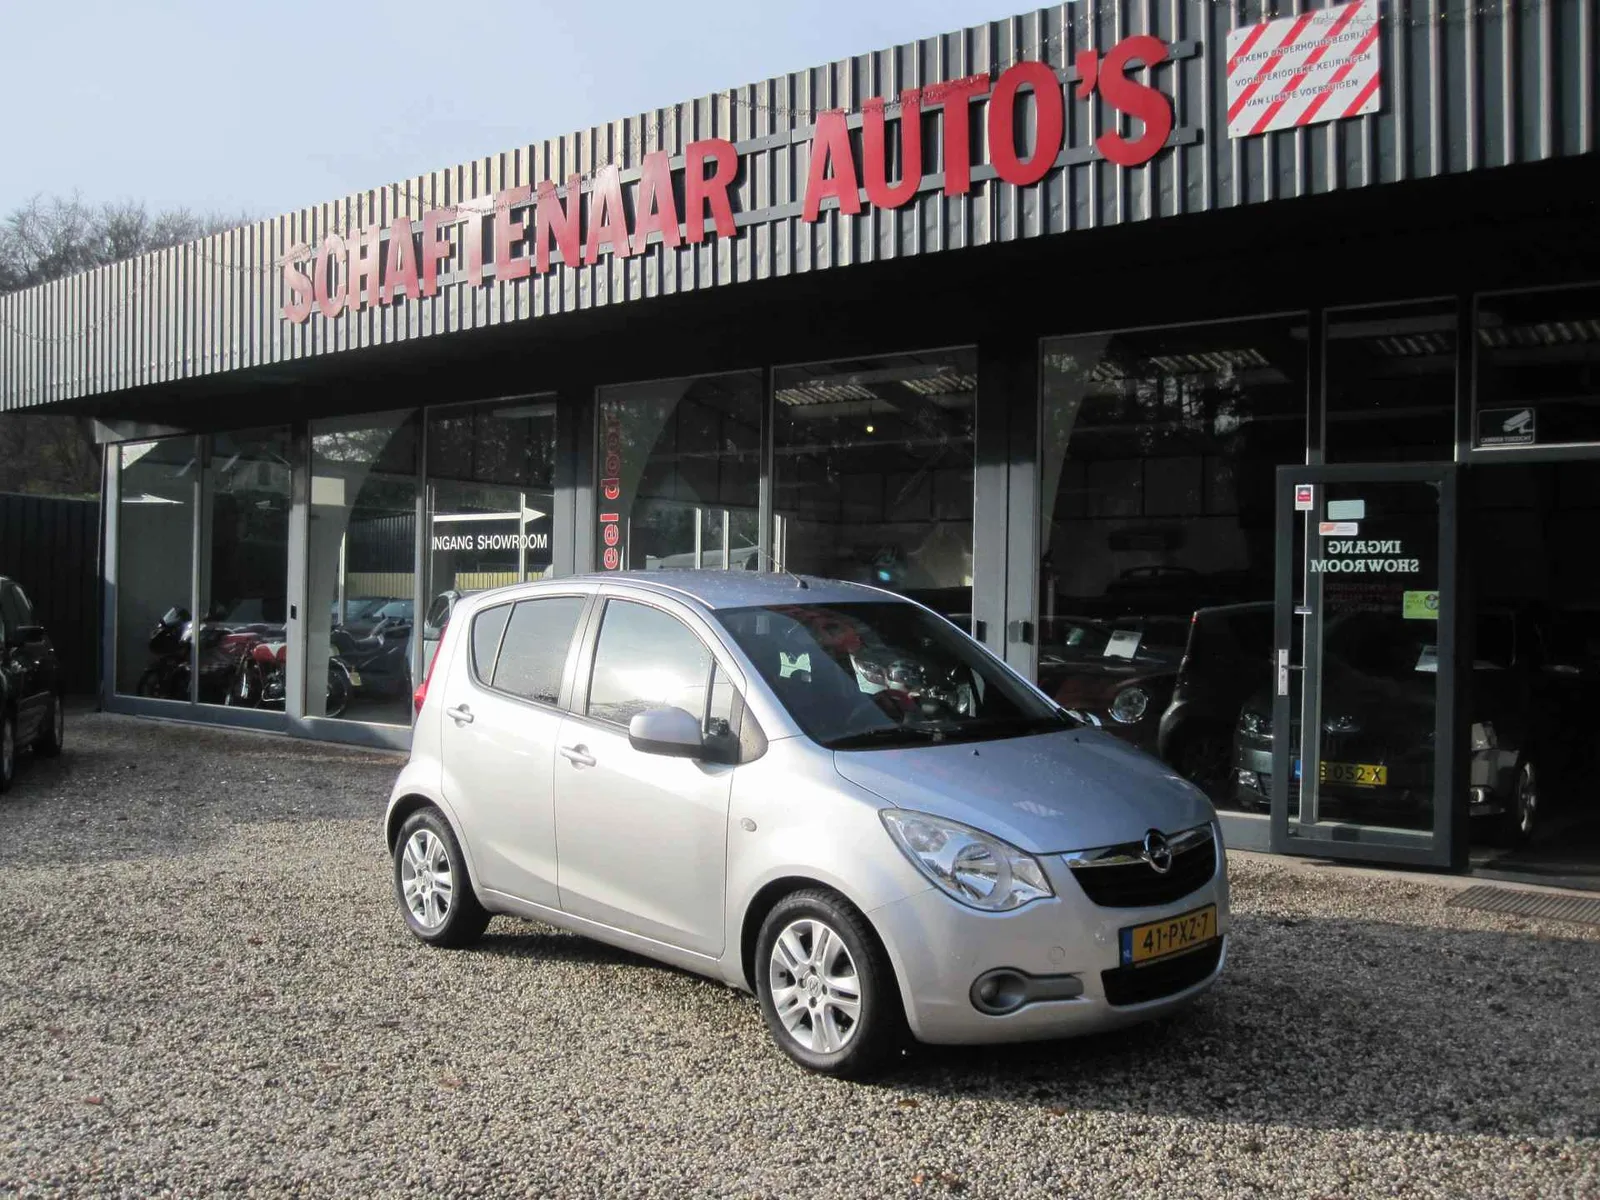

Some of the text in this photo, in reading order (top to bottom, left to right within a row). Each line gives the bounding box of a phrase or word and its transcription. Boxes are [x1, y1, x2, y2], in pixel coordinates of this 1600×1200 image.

[1234, 29, 1371, 65] ERKEND ONDERHOUDSBEDRIJF
[1235, 53, 1371, 87] VOOR PERIODIEKE KEURINGEN
[1246, 79, 1359, 107] VAN LICHTE VOERTUIGEN
[283, 35, 1173, 325] SCHAFTENAAR AUTO'S
[432, 534, 548, 550] INGANG SHOWROOM
[1142, 912, 1209, 954] 41-PXZ-7
